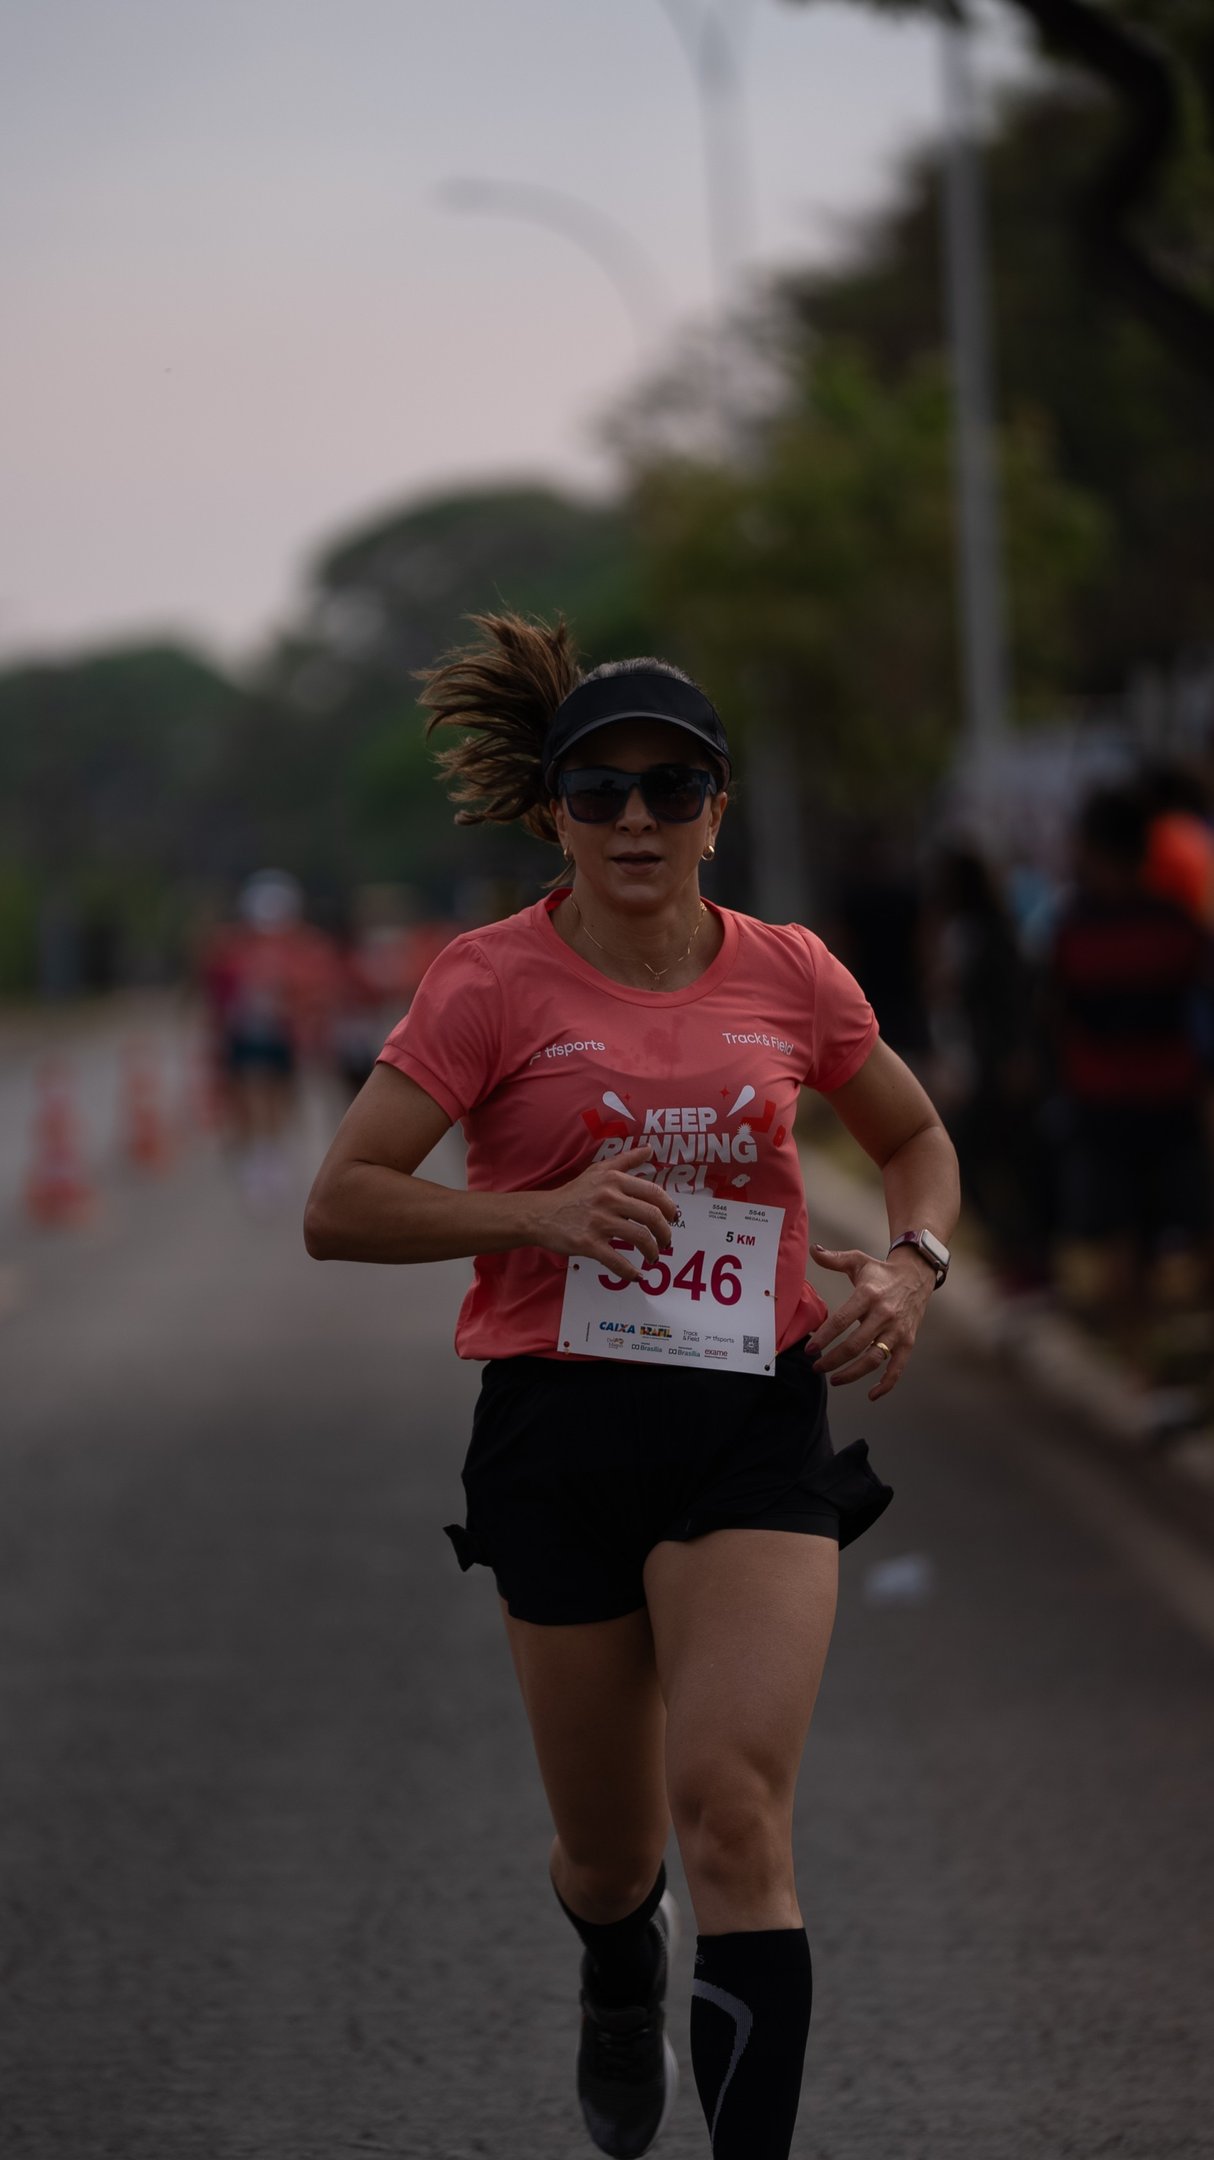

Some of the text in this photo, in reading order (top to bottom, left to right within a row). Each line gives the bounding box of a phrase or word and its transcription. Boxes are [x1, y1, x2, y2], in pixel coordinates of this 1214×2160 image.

[545, 1039, 605, 1058] tfsports
[722, 1032, 794, 1056] Track&Field
[643, 1107, 718, 1134] KEEP
[591, 1131, 758, 1165] RUNNING
[725, 1231, 756, 1246] 5 KM
[599, 1321, 636, 1334] CAIXA
